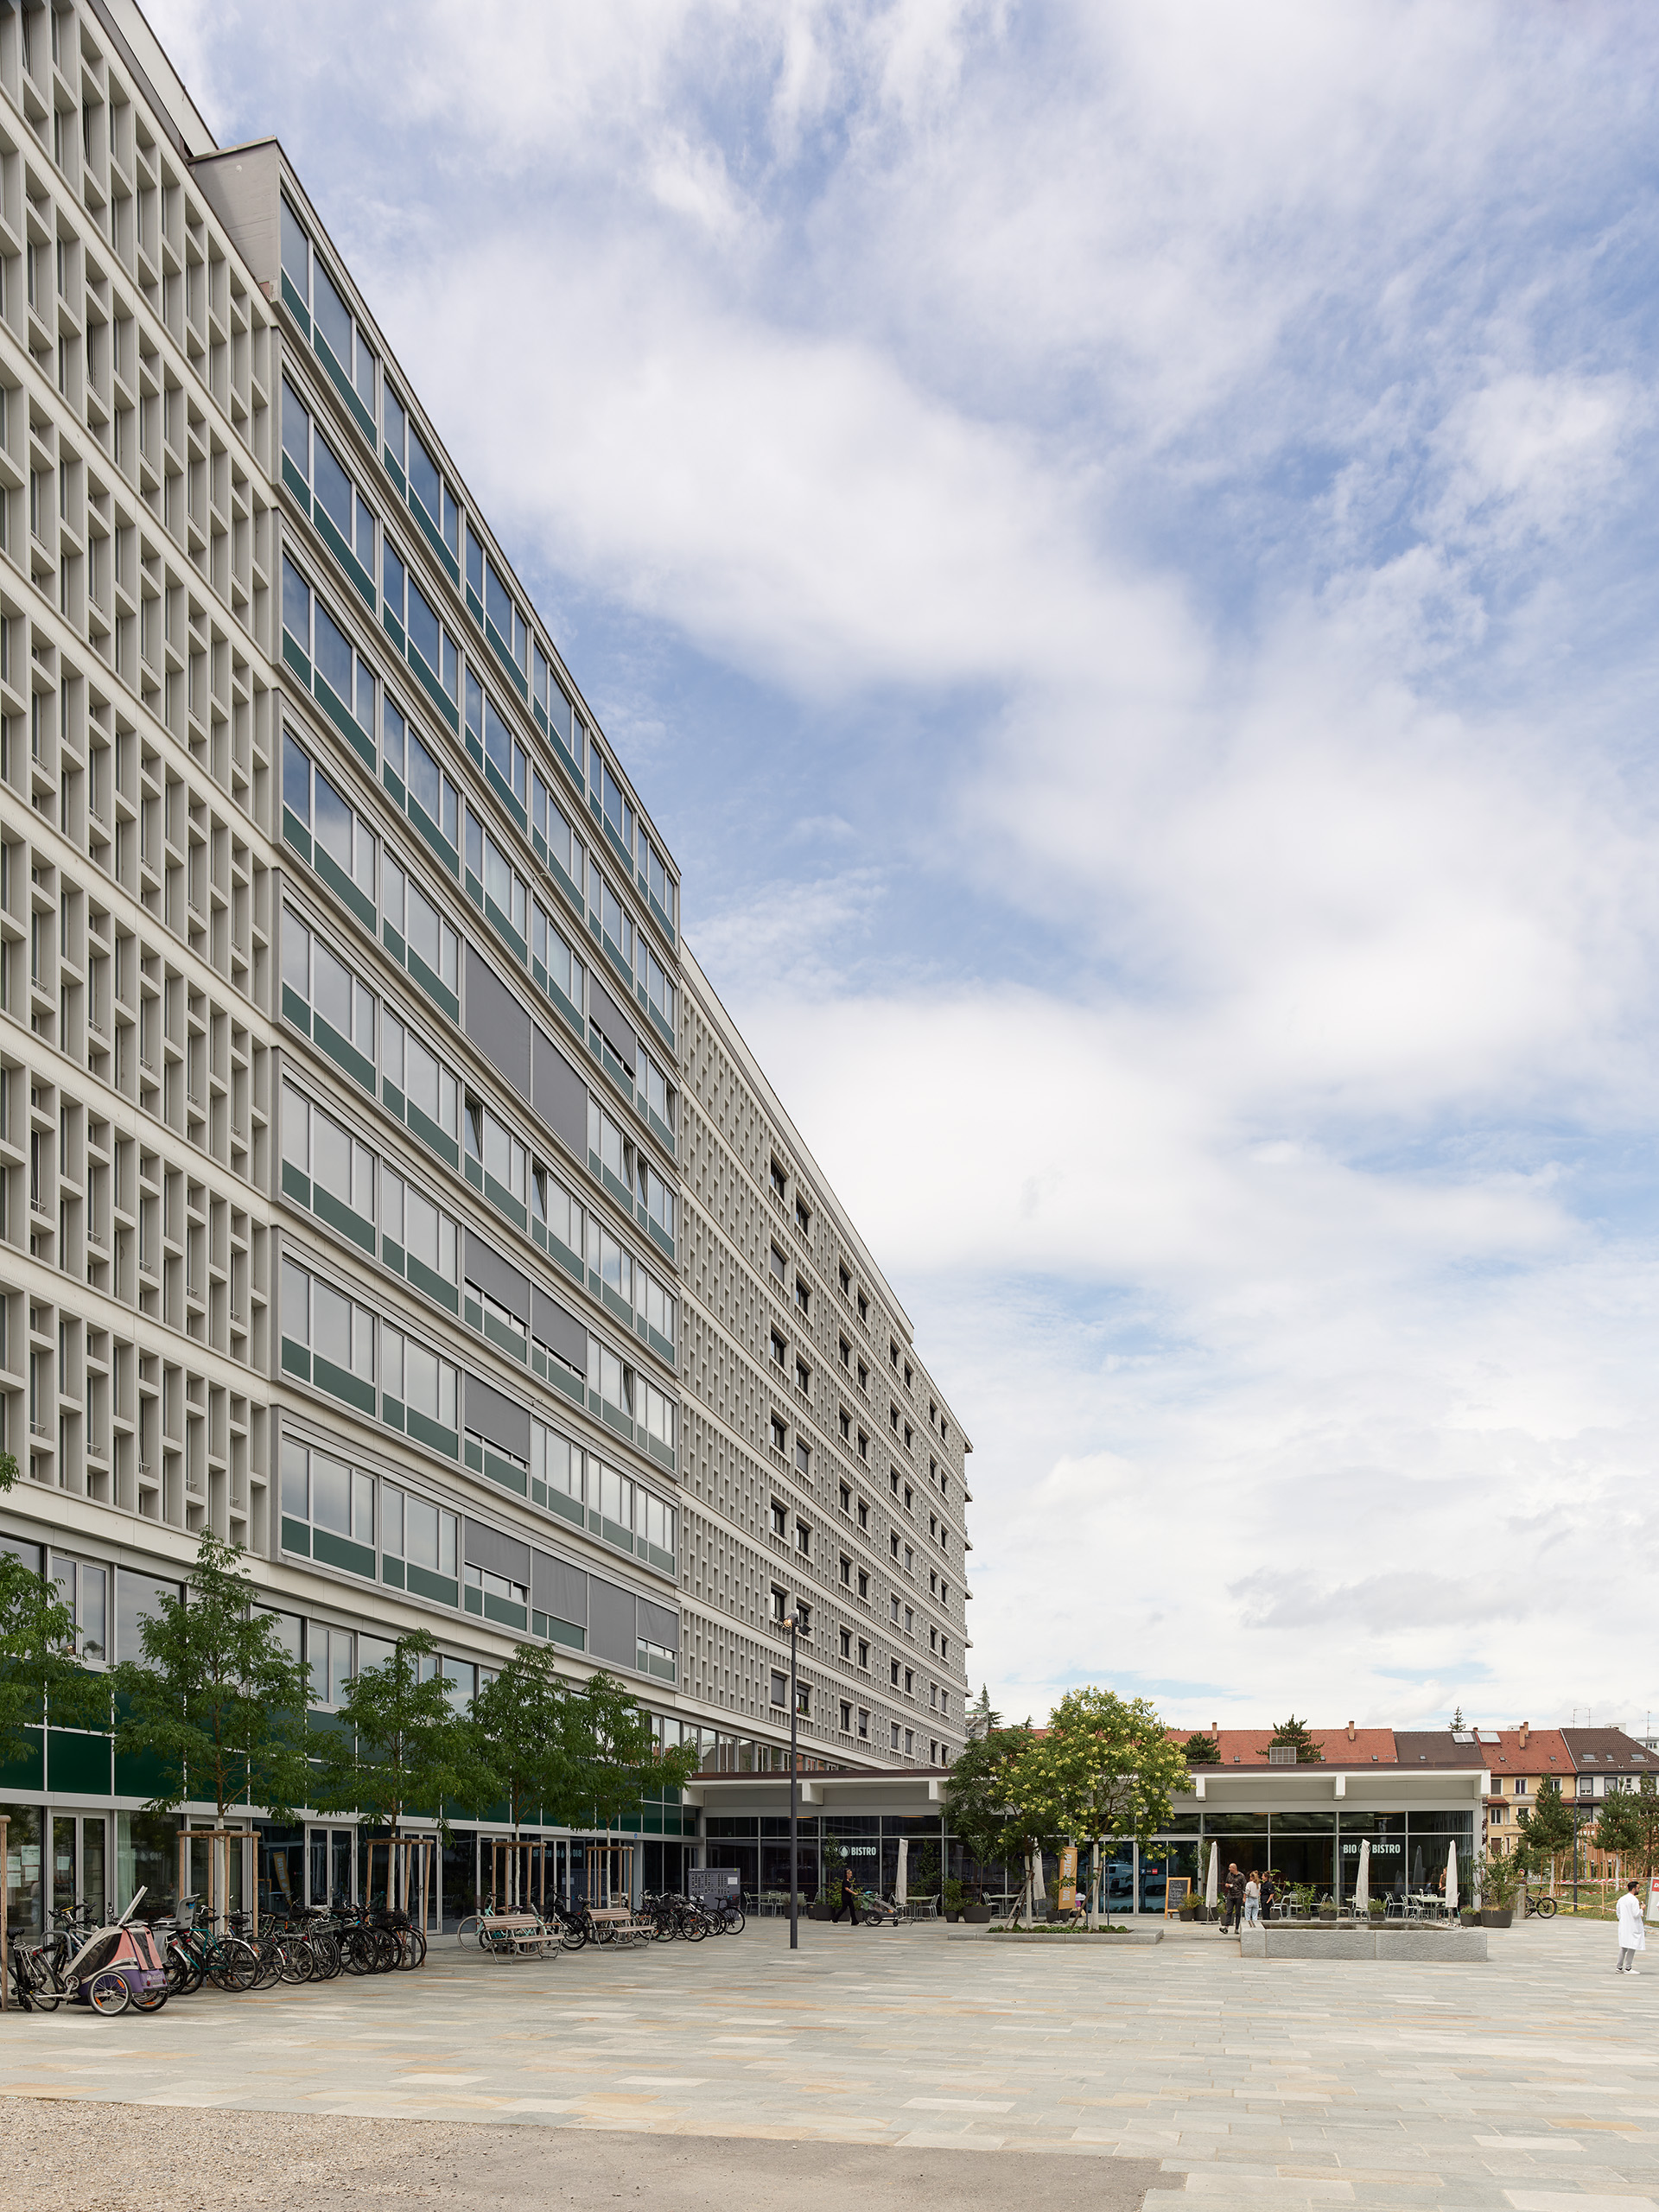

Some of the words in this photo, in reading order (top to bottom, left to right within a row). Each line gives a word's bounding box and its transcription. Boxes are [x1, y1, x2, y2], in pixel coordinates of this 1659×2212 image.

[850, 1847, 877, 1856] BISTRO
[1343, 1844, 1357, 1854] BIO
[1371, 1844, 1401, 1854] BISTRO
